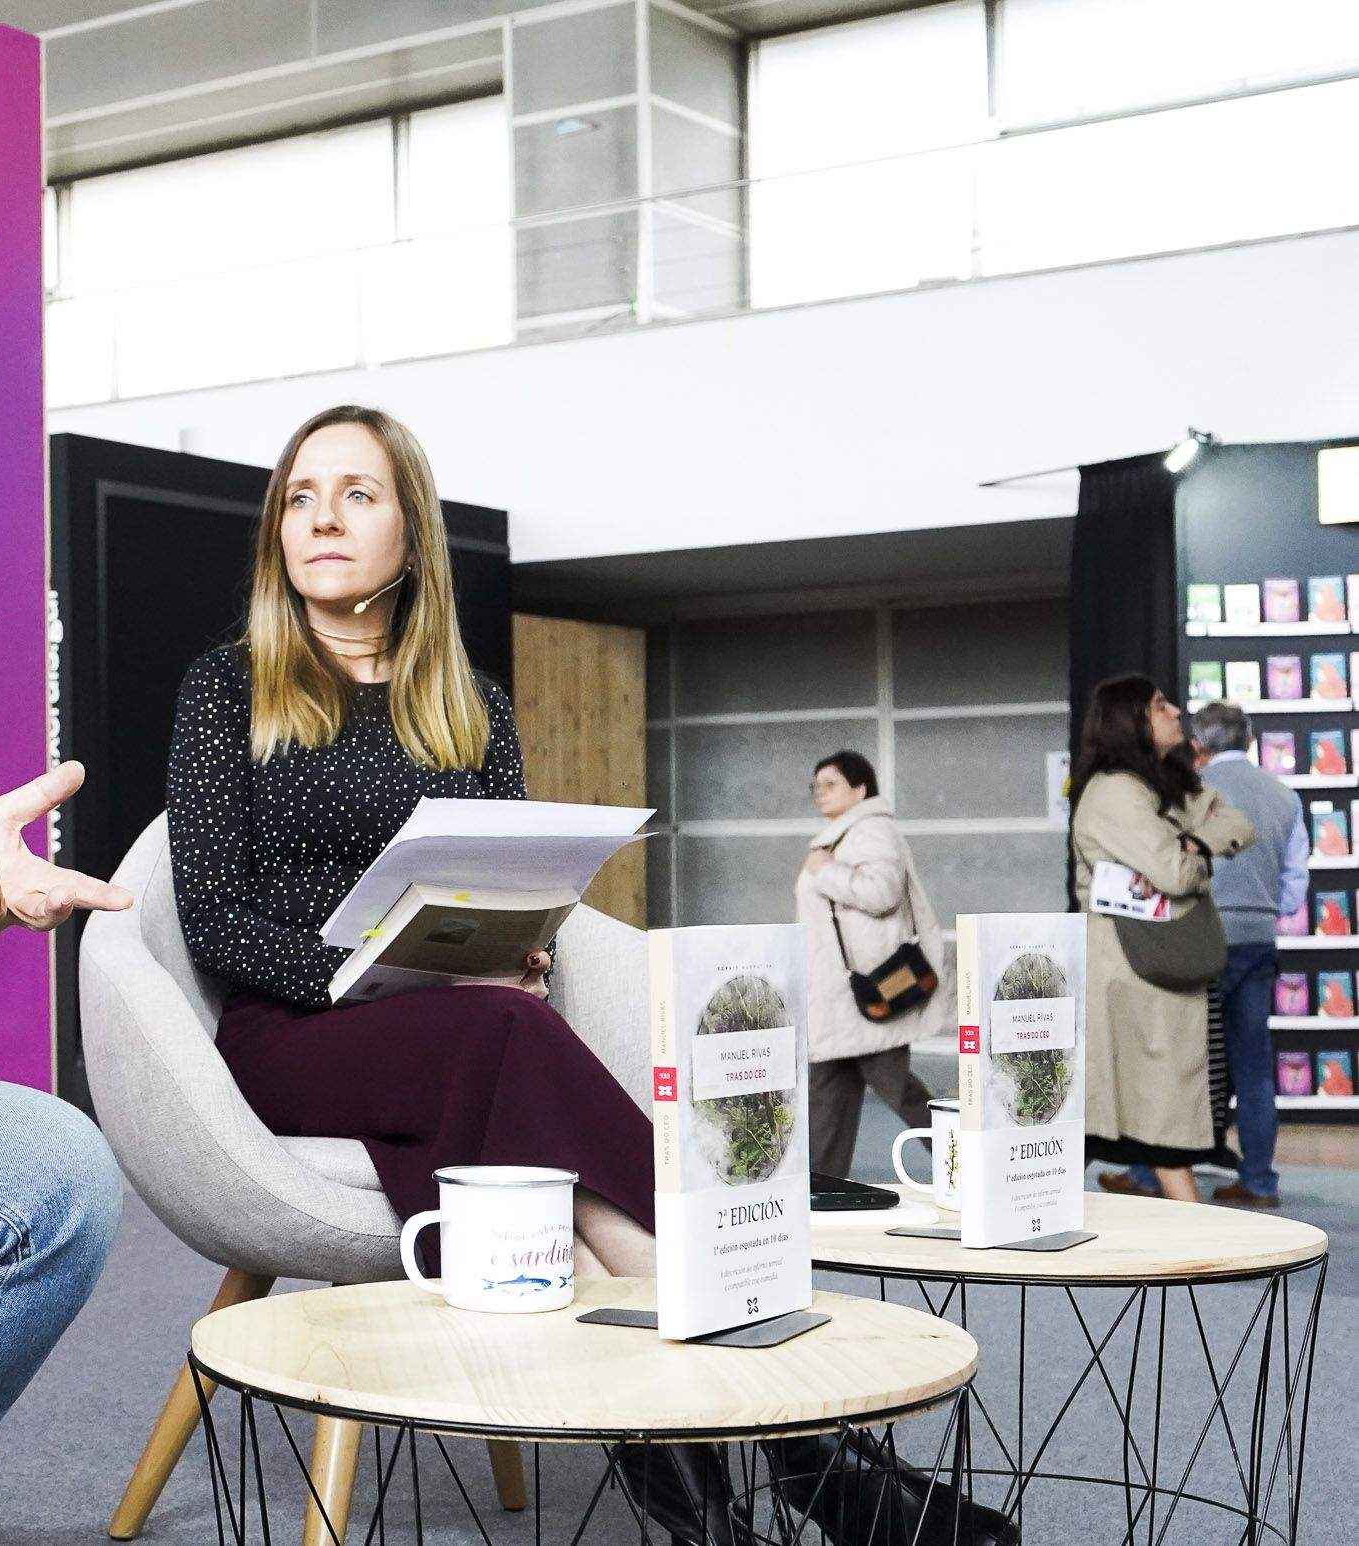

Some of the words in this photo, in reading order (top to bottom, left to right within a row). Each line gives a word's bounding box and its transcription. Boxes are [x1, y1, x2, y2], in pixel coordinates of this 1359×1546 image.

[1012, 1013, 1036, 1023] MANUEL
[1037, 1012, 1053, 1022] RIVAS
[1016, 1031, 1031, 1040] TRAS
[1032, 1031, 1039, 1039] DO
[1040, 1030, 1050, 1039] CEO
[720, 1049, 750, 1061] MANUEL
[751, 1047, 771, 1059] RIVAS
[725, 1071, 743, 1082] TRAS
[744, 1070, 753, 1080] DO
[754, 1069, 767, 1079] CEO
[1020, 1136, 1063, 1160] EDICIÓN
[730, 1195, 784, 1227] EDICIÓN
